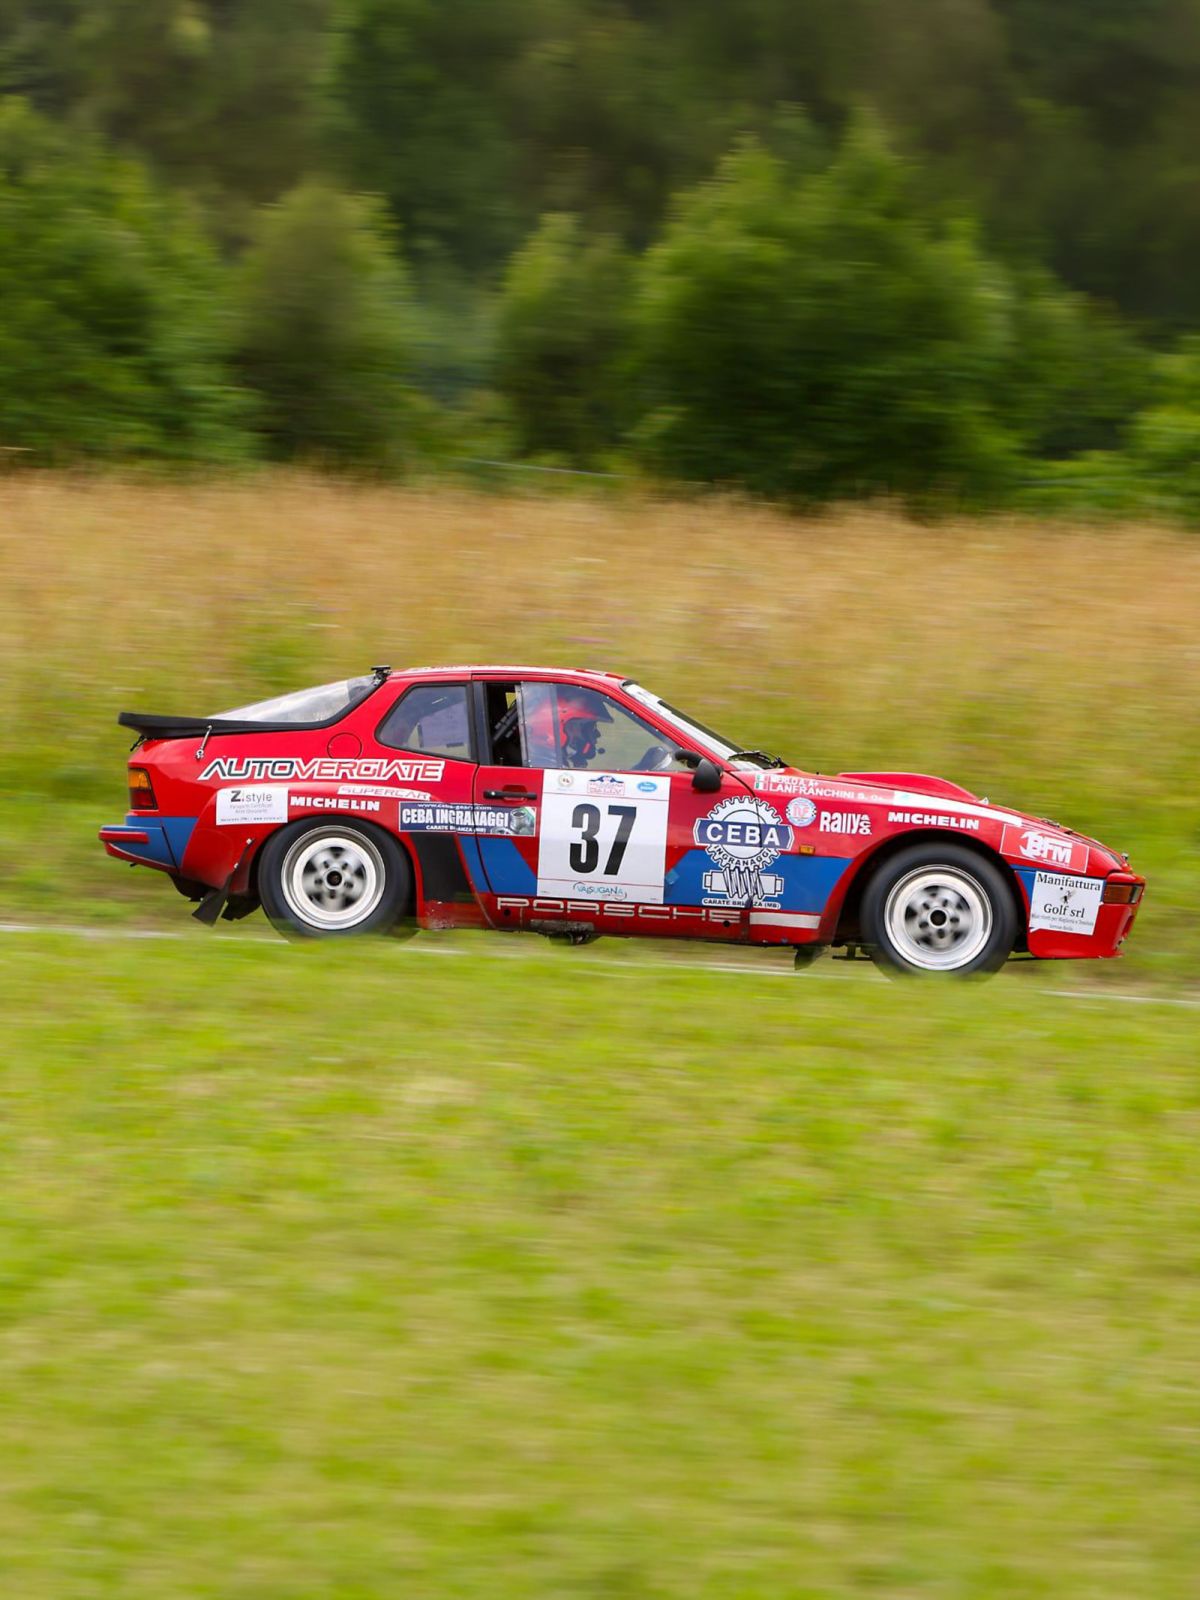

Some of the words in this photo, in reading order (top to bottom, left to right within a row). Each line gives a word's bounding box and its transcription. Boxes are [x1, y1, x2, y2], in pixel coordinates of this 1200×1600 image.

[198, 758, 445, 781] AUTOVERGIATE
[341, 787, 428, 799] SUPERCAR
[769, 784, 854, 799] LANFRANCHINI
[290, 797, 380, 811] MICHELIN
[402, 808, 433, 824] CEBA
[435, 809, 509, 827] INGRANAGGI
[820, 811, 861, 834] Rally
[888, 812, 980, 830] MICHELIN
[569, 803, 637, 876] 37
[706, 822, 780, 846] CEBA
[713, 845, 773, 867] INGRANAGGI
[1036, 873, 1101, 891] Manifattura
[497, 897, 741, 923] PORSCHE
[1043, 903, 1068, 915] Golf
[1070, 907, 1085, 918] srl
